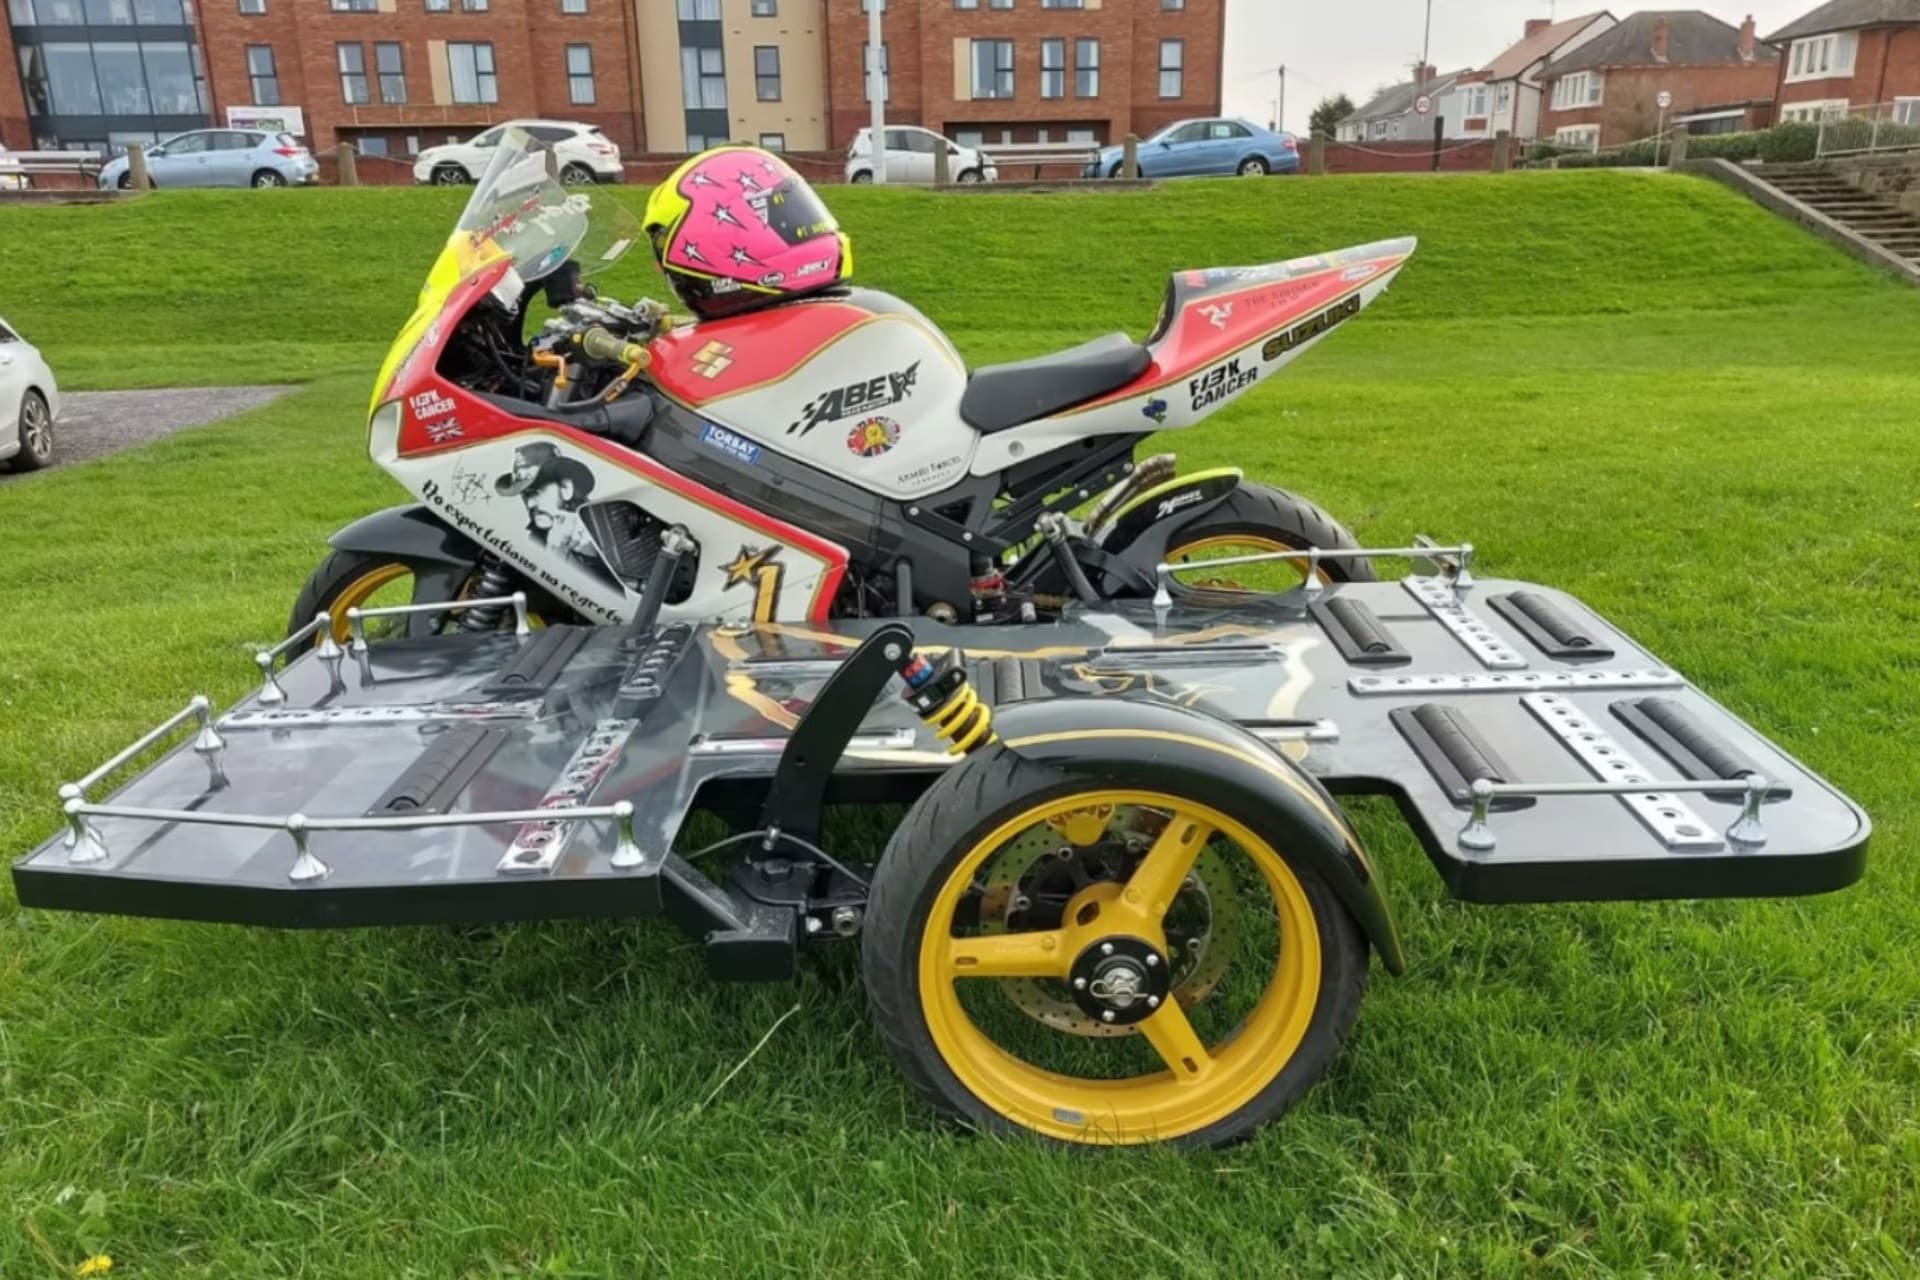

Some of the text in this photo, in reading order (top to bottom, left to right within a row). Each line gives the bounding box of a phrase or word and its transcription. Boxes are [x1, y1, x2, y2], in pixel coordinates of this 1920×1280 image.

[1262, 293, 1360, 361] SUZUKI
[799, 360, 921, 438] ABEY
[1192, 366, 1258, 411] CANCER
[710, 425, 757, 455] TORBAY
[445, 504, 537, 572] expectations
[540, 569, 559, 586] no
